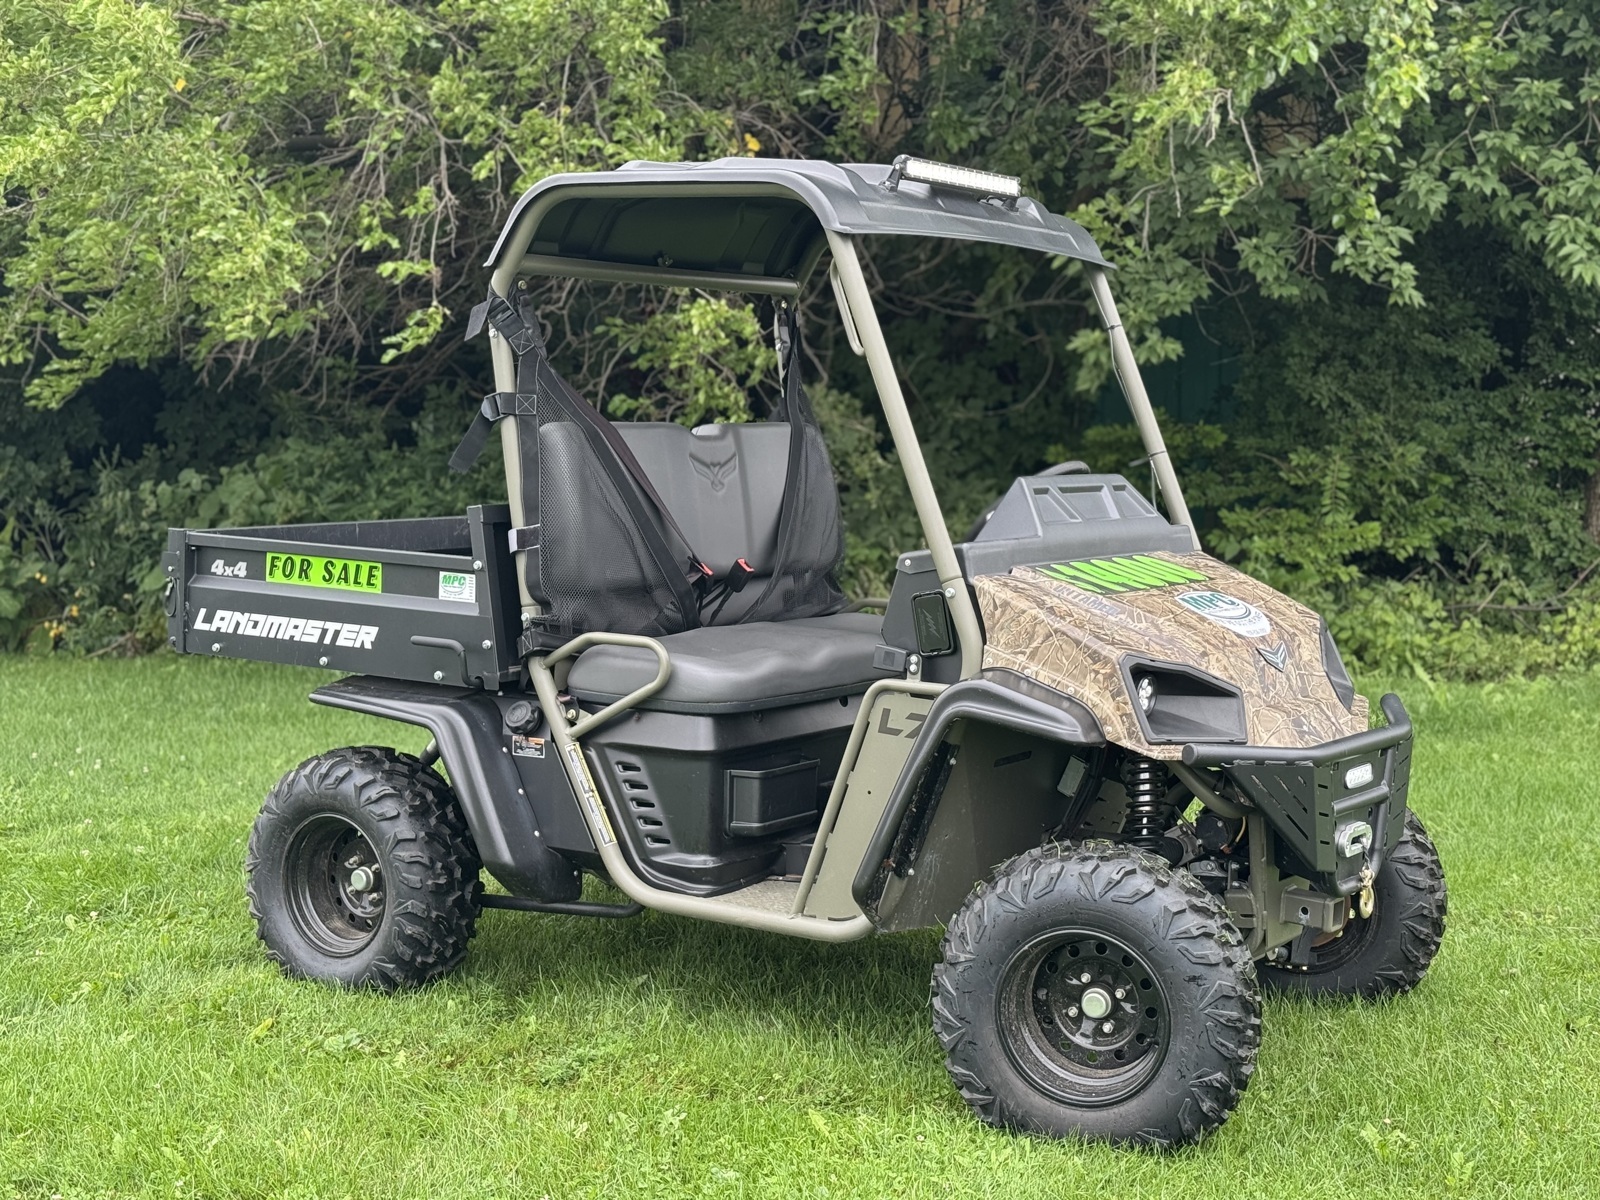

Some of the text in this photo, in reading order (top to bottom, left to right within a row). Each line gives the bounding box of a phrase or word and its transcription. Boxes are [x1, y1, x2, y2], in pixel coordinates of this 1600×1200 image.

[210, 559, 247, 578] 4x4
[268, 554, 380, 588] FOR SALE
[441, 574, 467, 586] MPC
[1178, 592, 1239, 611] MPC
[193, 607, 380, 650] LANDMASTER
